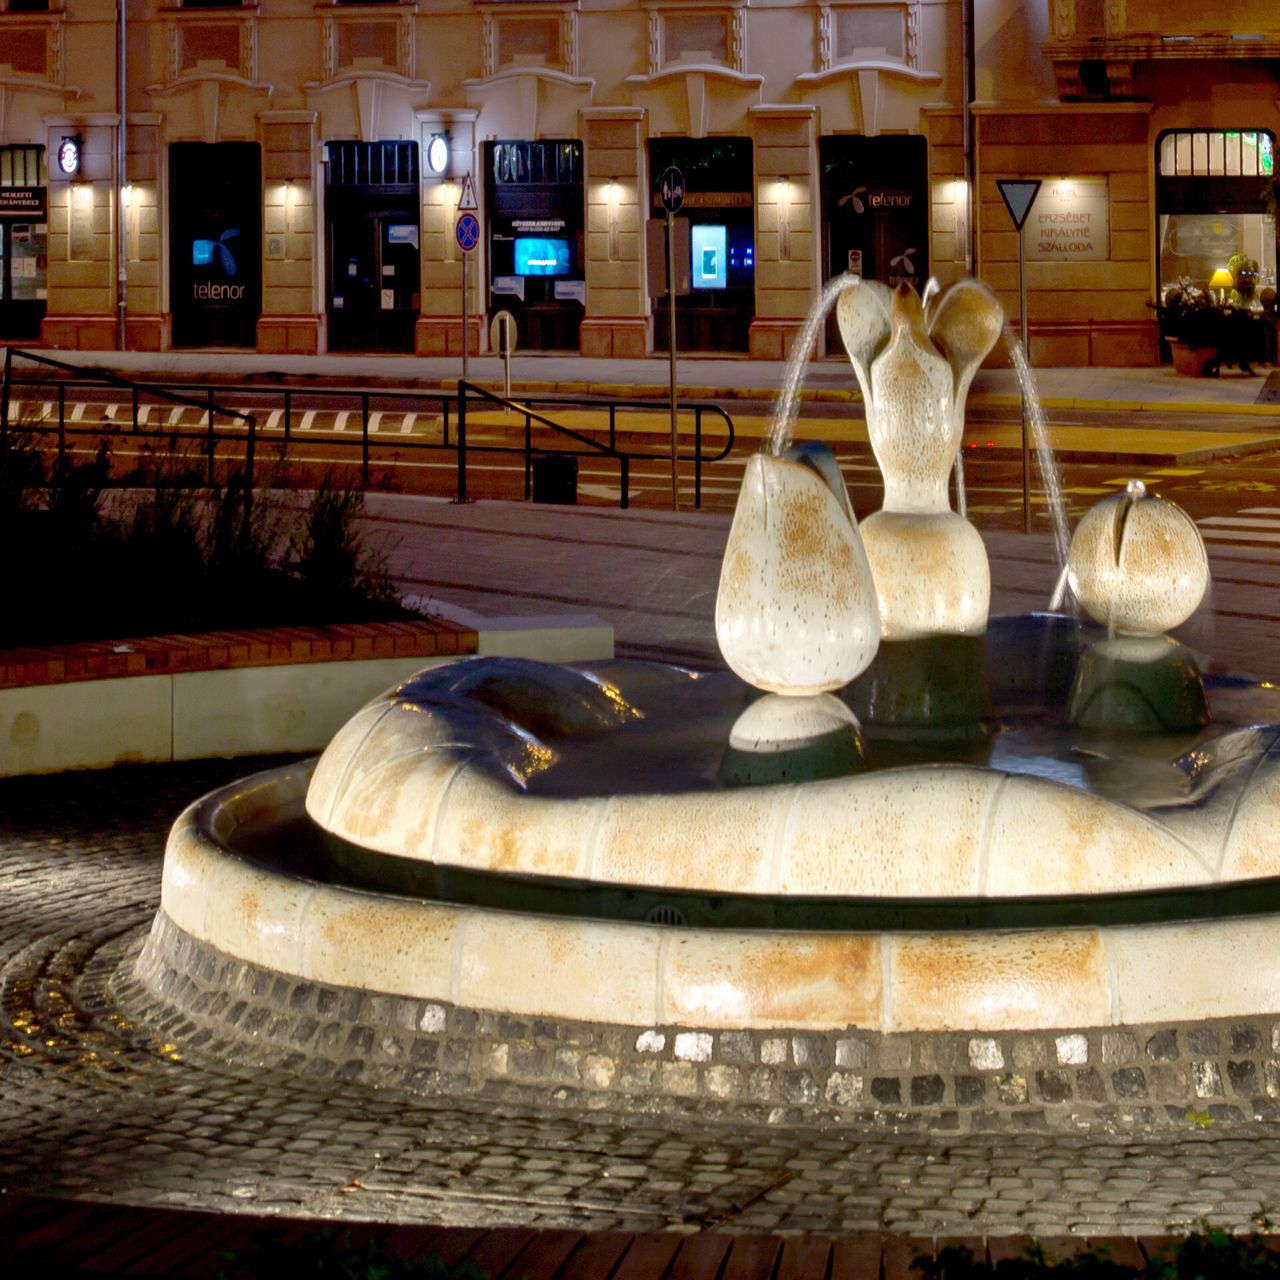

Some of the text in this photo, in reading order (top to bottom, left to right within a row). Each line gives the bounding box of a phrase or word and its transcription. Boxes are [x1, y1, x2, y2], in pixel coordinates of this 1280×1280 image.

[868, 192, 913, 207] telenor
[1039, 212, 1092, 223] ERZSÉBET
[1040, 226, 1090, 238] KIRÁLYNÉ
[1038, 241, 1094, 252] SZÁLLODA
[193, 281, 246, 299] telenor
